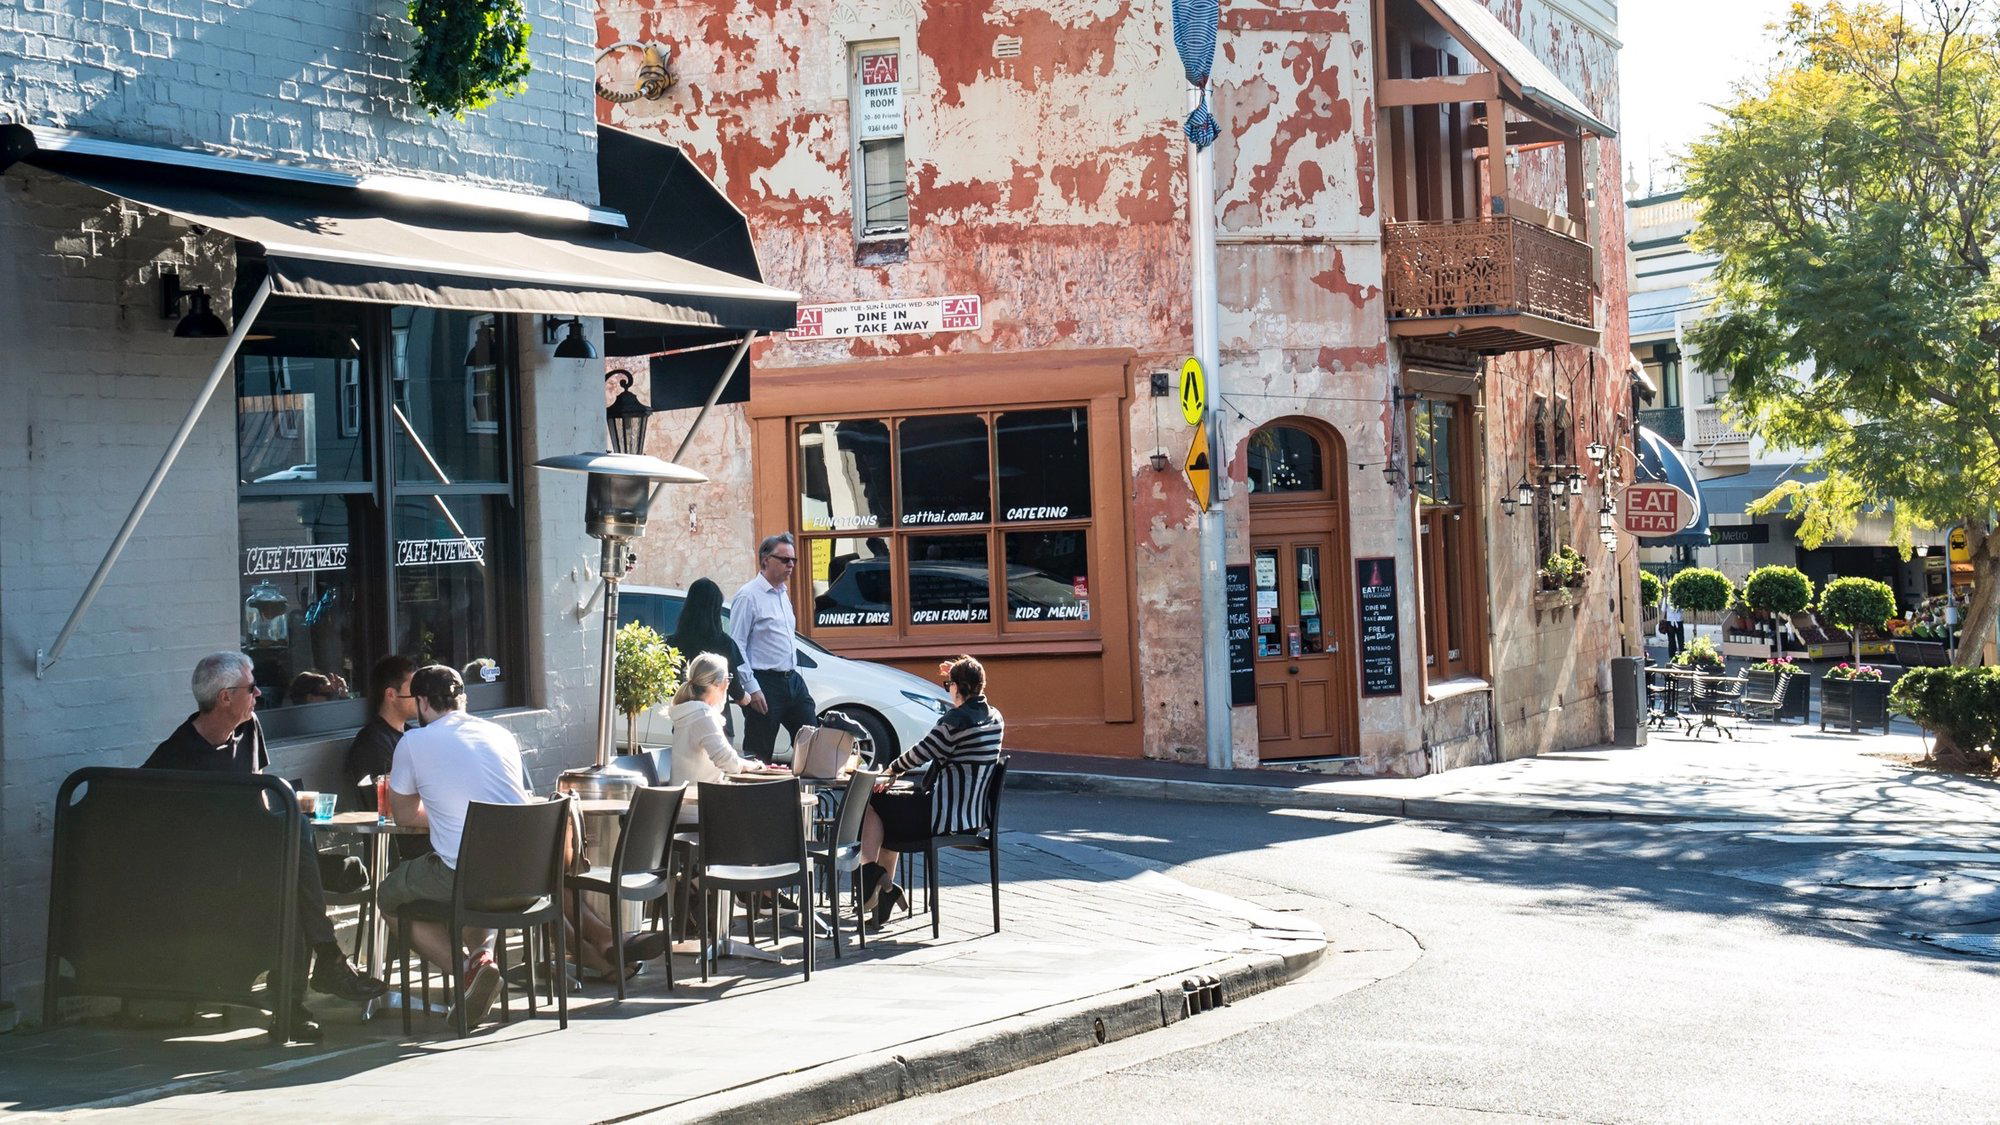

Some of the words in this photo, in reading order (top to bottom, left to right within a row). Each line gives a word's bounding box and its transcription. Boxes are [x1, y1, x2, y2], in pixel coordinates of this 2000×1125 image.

[864, 55, 896, 71] EAT
[864, 72, 898, 84] THAI
[865, 87, 898, 97] PRIVATE
[870, 99, 894, 108] ROOM
[942, 299, 978, 314] EAT
[797, 309, 821, 324] AT
[857, 312, 887, 322] DINE
[894, 311, 907, 320] IN
[943, 316, 978, 328] THAI
[855, 324, 887, 333] TAKE
[894, 320, 929, 331] AWAY
[1628, 491, 1674, 511] EAT
[902, 510, 984, 524] eatthai.com.au
[1006, 506, 1068, 520] CATERING
[813, 515, 878, 528] FUNCTIONS
[1628, 516, 1674, 529] THAI
[1722, 530, 1748, 541] Metro
[818, 613, 856, 624] DINNER
[858, 613, 865, 624] 7
[866, 612, 890, 623] DAYS
[913, 611, 940, 622] OPEN
[942, 610, 970, 621] FROM
[971, 610, 977, 620] 5
[1015, 606, 1041, 619] KIDS
[1047, 606, 1082, 618] MENU
